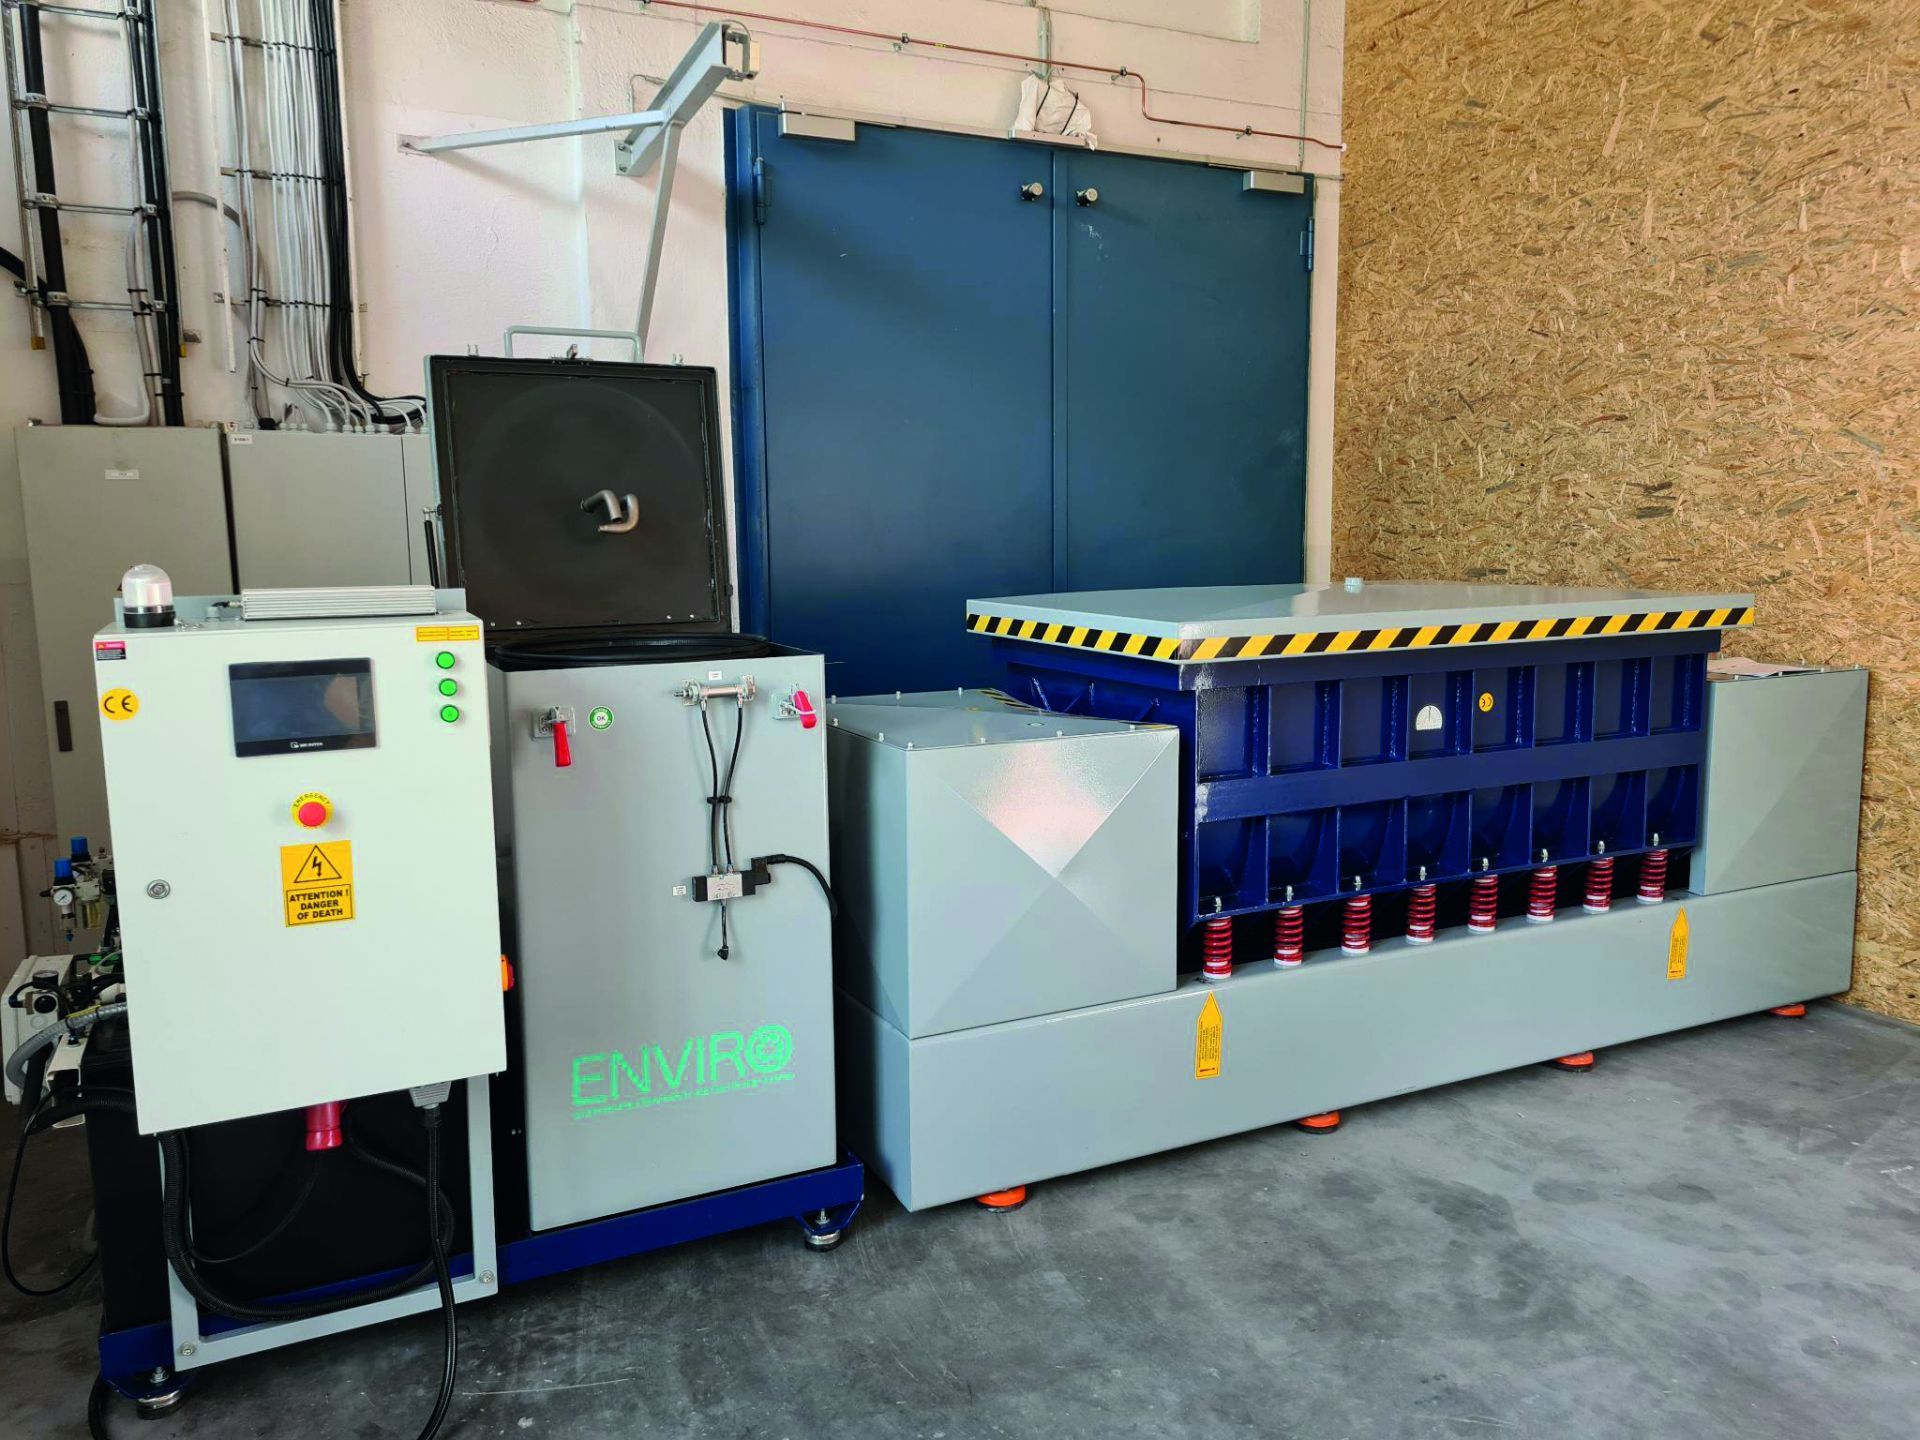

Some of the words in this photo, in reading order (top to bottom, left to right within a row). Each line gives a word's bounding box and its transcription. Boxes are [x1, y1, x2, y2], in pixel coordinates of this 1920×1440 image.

[104, 695, 133, 714] CE
[290, 889, 343, 902] ATTENTION
[301, 899, 339, 910] DANGER
[297, 911, 310, 920] OF
[312, 908, 344, 919] DEATH
